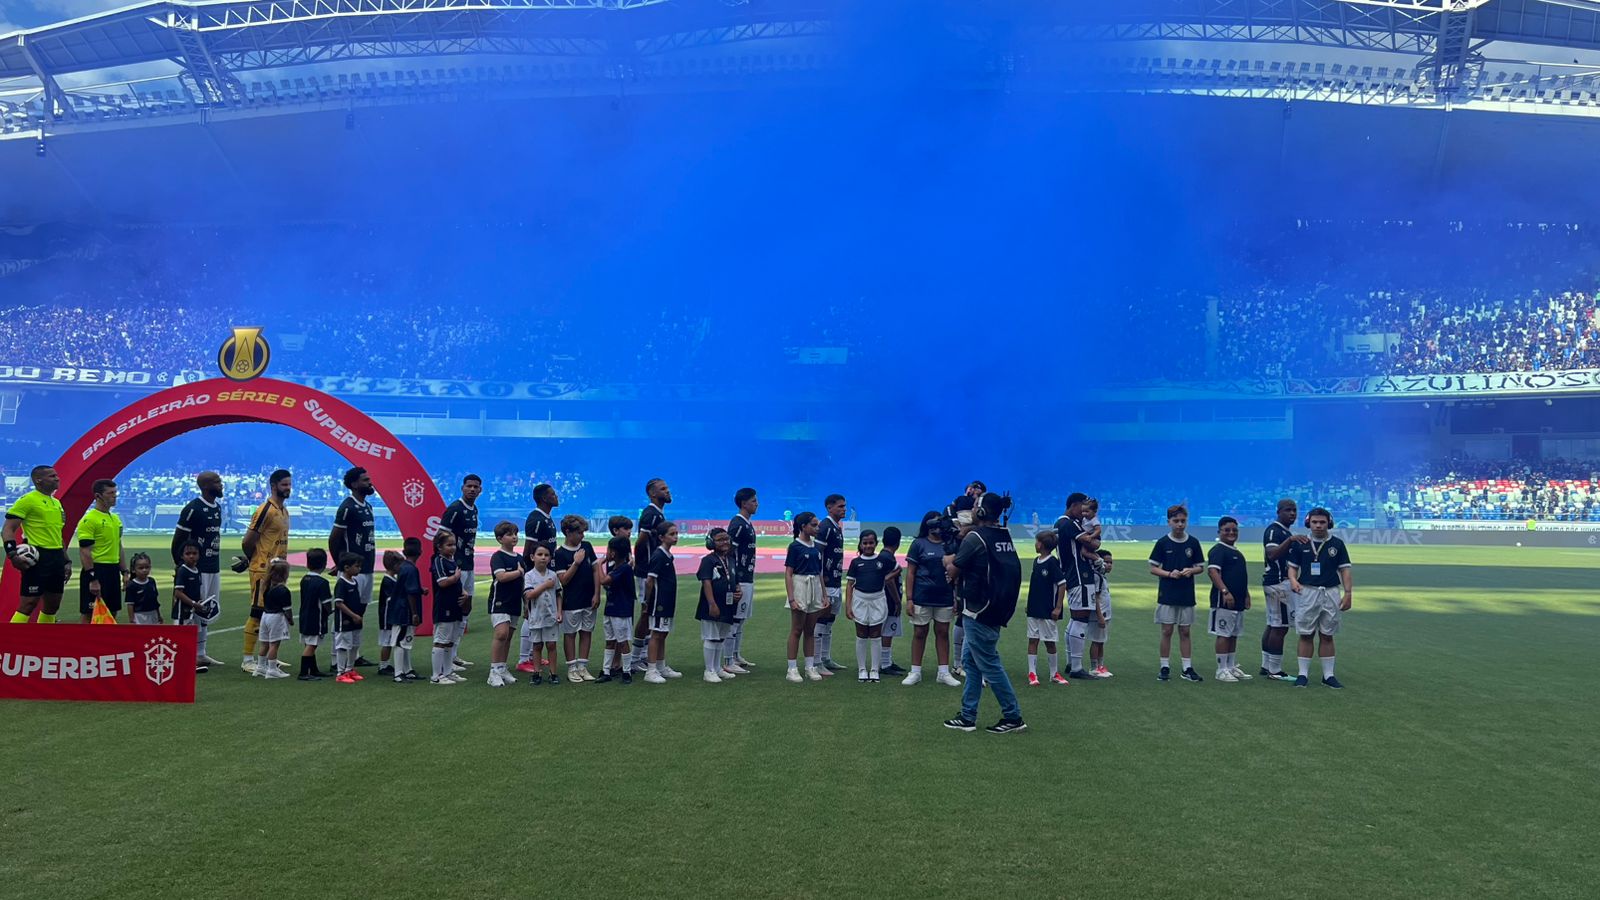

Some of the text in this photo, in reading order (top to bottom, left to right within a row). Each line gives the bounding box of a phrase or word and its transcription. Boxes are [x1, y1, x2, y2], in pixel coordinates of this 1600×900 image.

[51, 367, 151, 384] REMO
[81, 388, 297, 461] BRASILEIRÃO SÉRIE B
[303, 398, 397, 461] SUPERBET
[0, 651, 135, 679] UPERBET
